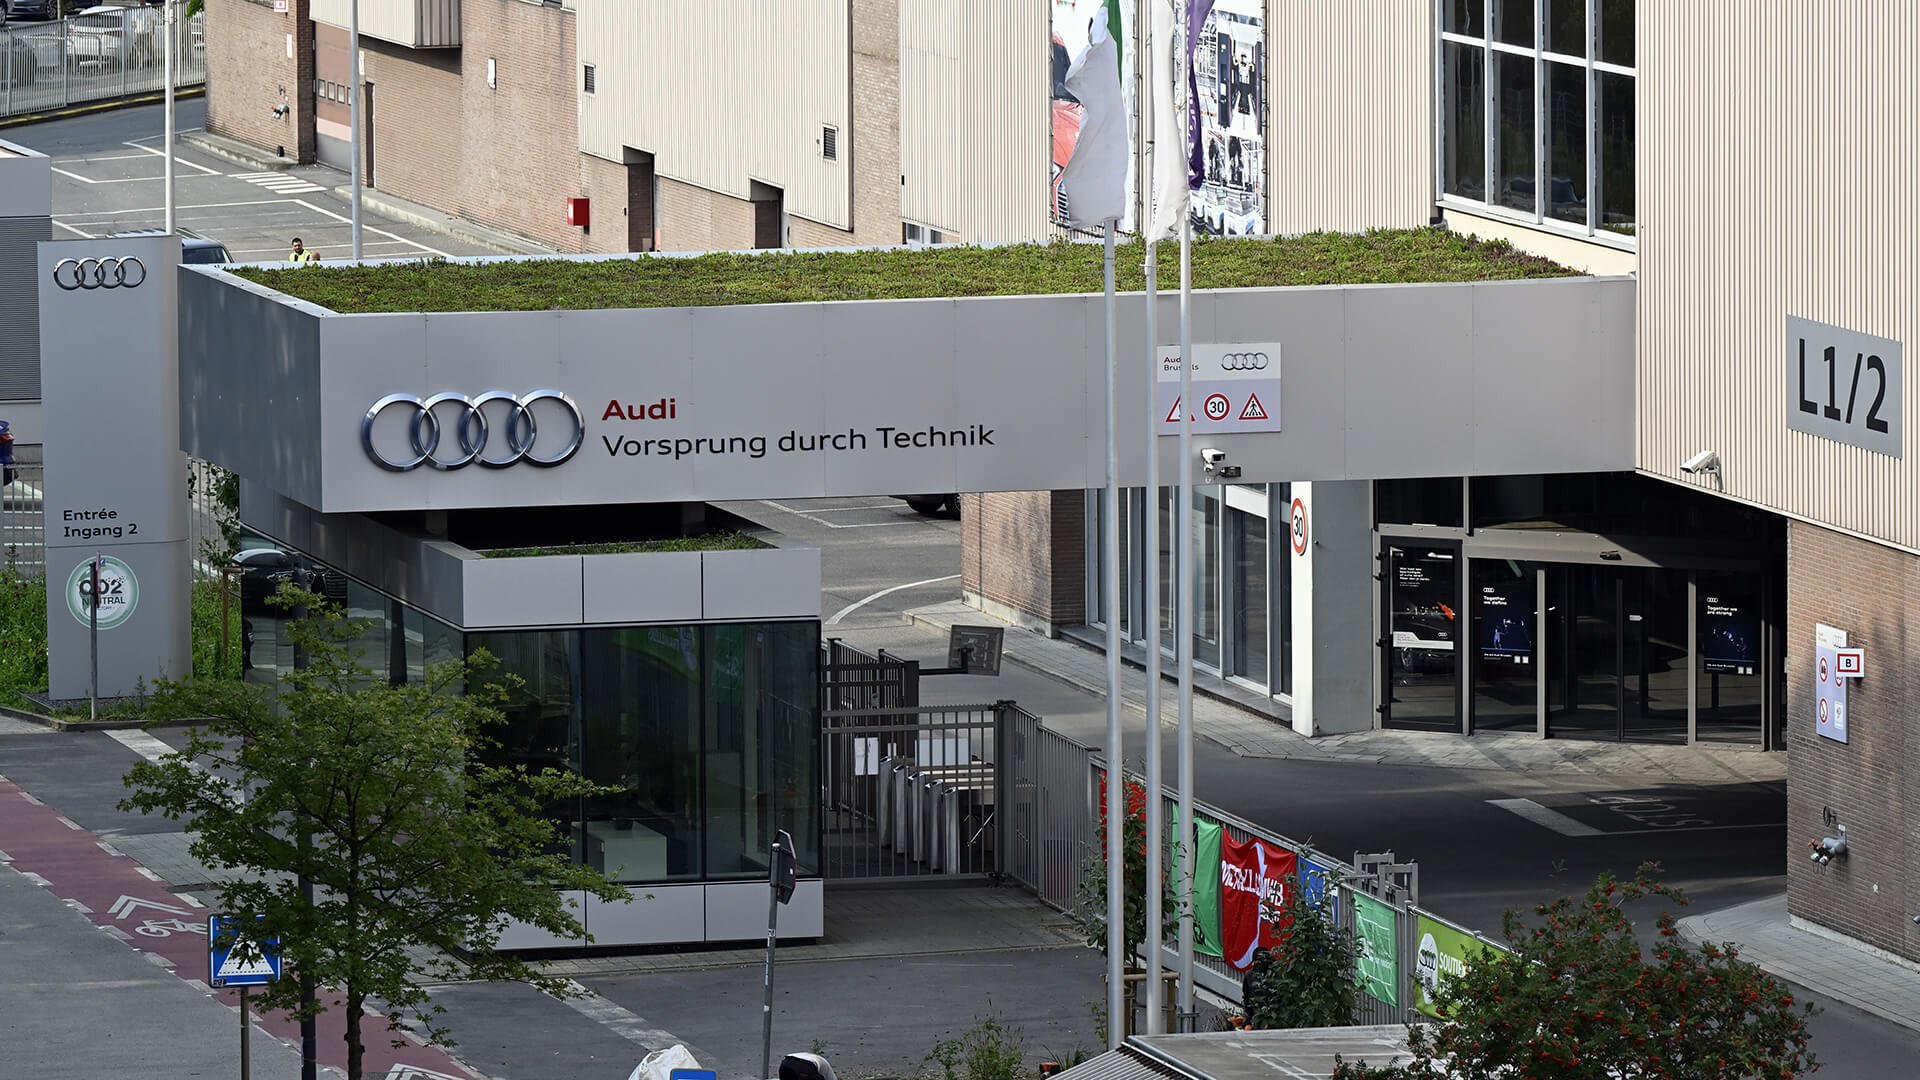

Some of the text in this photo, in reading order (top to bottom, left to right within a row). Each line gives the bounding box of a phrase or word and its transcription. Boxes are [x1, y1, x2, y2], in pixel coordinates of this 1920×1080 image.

[1163, 356, 1181, 364] Aud
[1163, 364, 1200, 372] Bruls
[1799, 338, 1889, 434] L1/2
[602, 399, 677, 421] Audi
[1209, 401, 1225, 414] 30
[602, 424, 996, 460] Vorsprung durch Technik
[63, 508, 118, 521] Entrée
[64, 523, 138, 539] Ingang 2
[1294, 514, 1304, 538] 30
[82, 596, 126, 605] NTRAL
[1845, 658, 1852, 668] B
